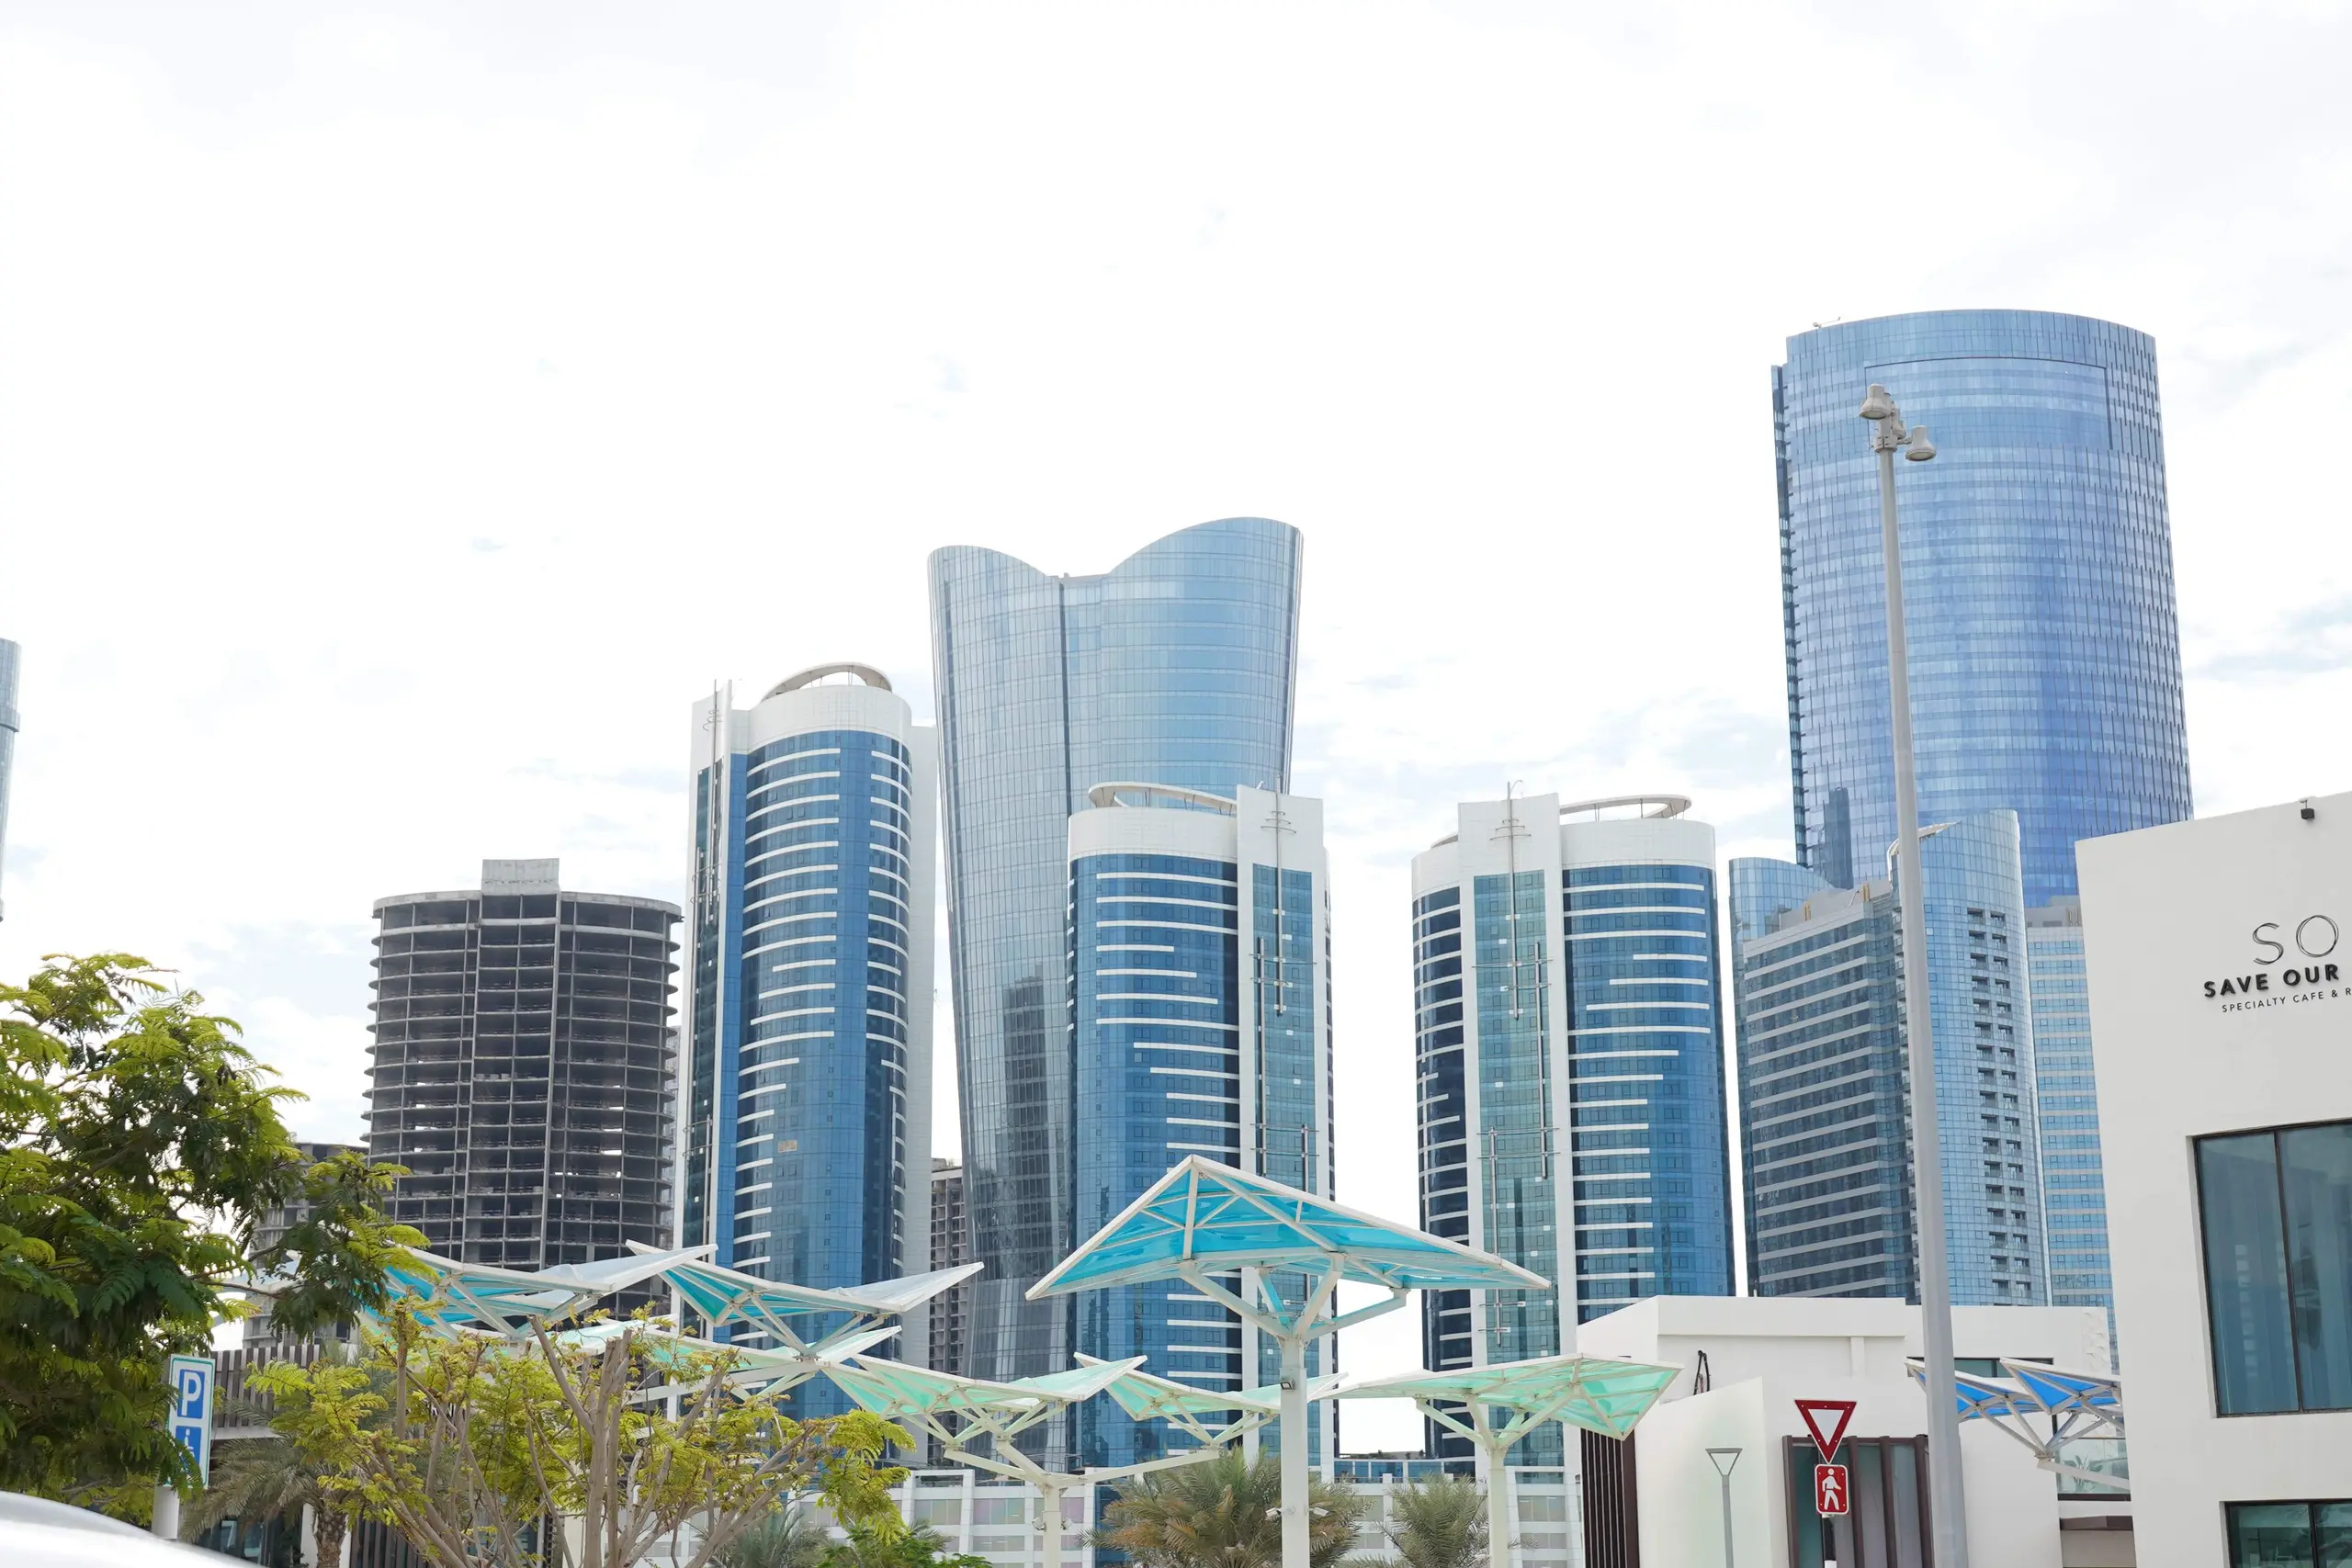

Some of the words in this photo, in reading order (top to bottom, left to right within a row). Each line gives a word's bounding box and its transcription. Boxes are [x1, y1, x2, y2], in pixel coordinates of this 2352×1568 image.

[2204, 974, 2269, 998] SAVE
[2282, 964, 2339, 986] OUR
[2222, 997, 2286, 1012] SPECIALTY
[2292, 991, 2324, 1003] CAFE
[2331, 989, 2338, 998] &
[181, 1371, 202, 1416] P
